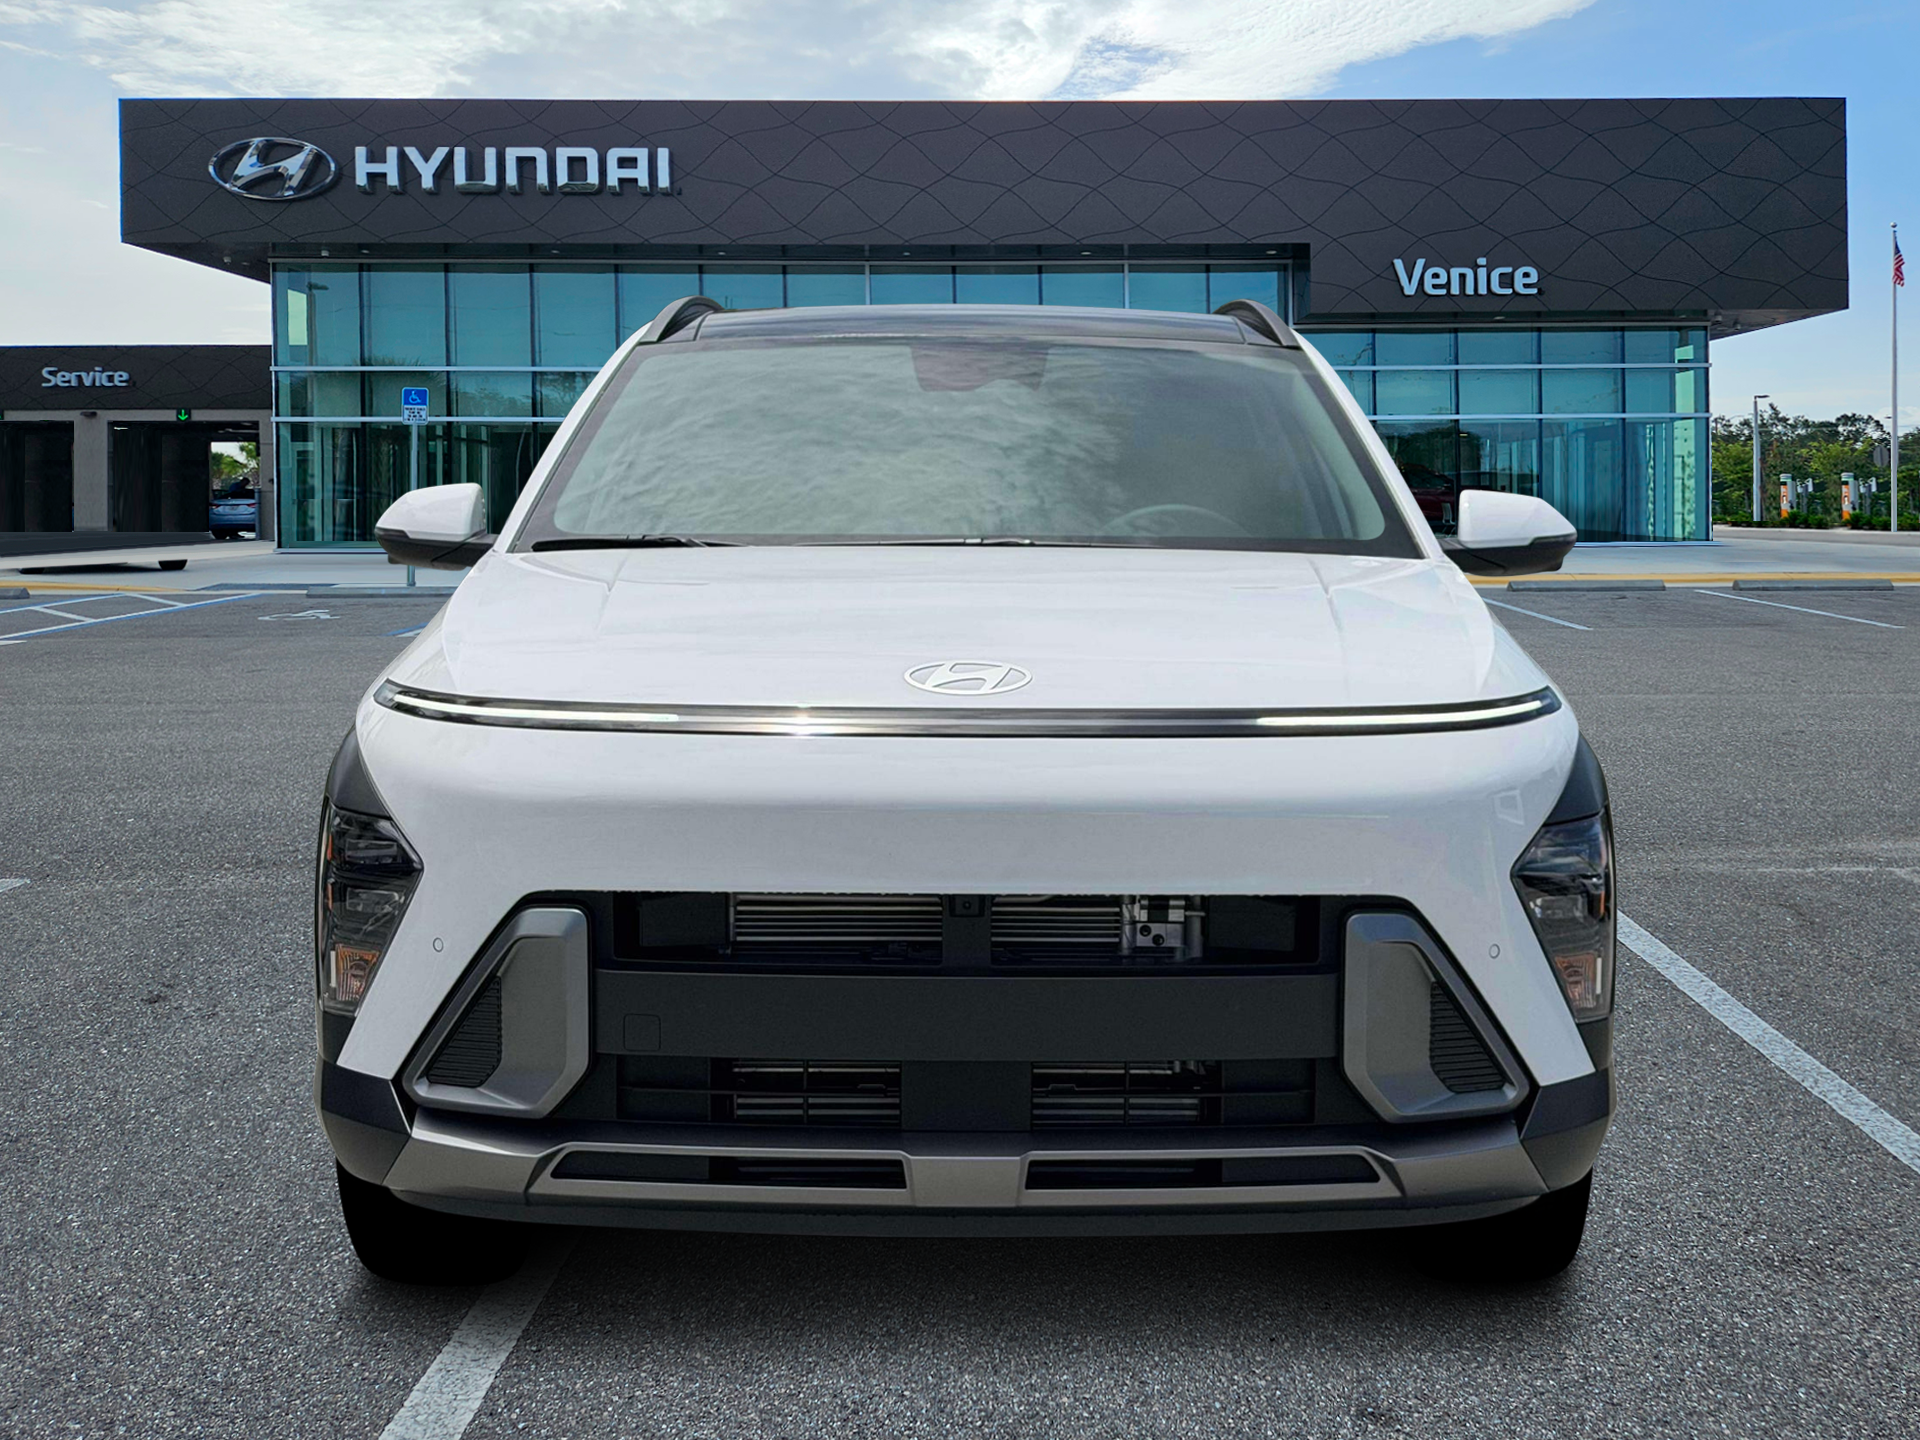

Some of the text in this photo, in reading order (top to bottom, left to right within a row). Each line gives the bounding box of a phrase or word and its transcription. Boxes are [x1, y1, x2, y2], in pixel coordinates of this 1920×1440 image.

[354, 146, 670, 194] HYUNDAI
[1393, 256, 1539, 296] Venice
[41, 366, 130, 387] Service
